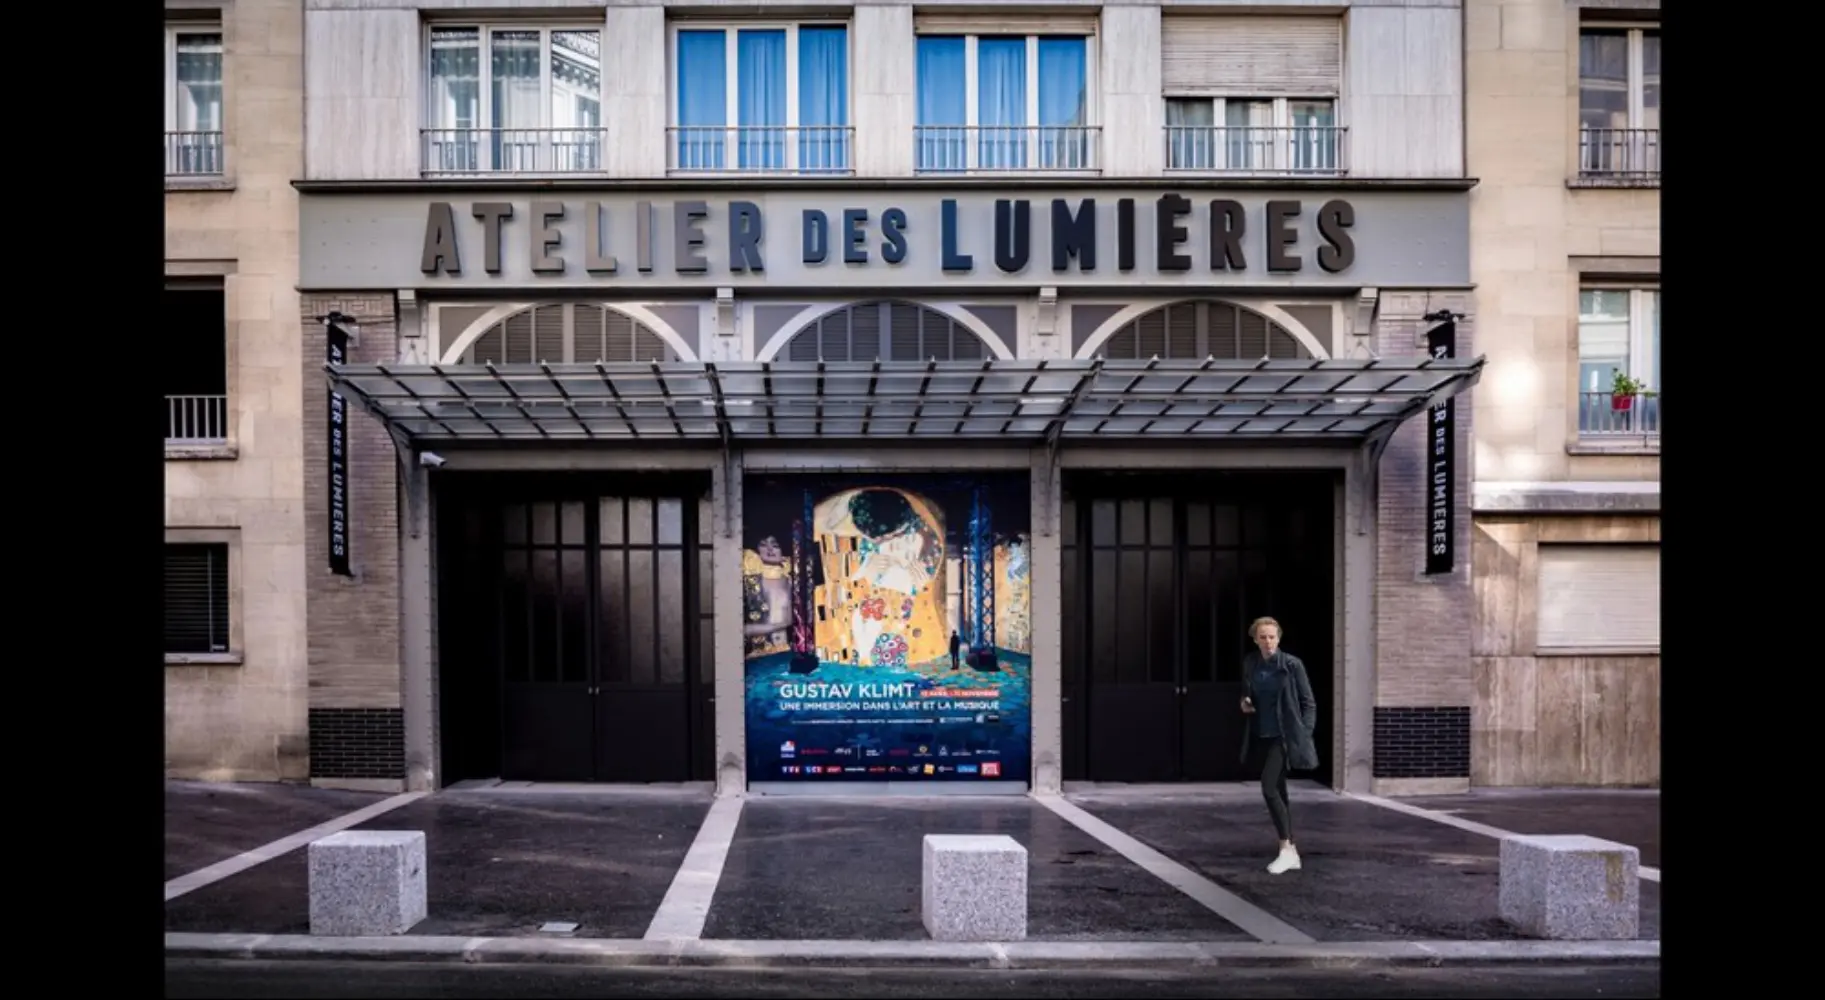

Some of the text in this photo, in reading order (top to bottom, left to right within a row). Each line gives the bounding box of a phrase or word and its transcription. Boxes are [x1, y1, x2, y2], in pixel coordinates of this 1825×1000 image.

[420, 200, 766, 275] ATELIER
[802, 208, 907, 265] DES
[332, 427, 342, 456] DES
[1435, 427, 1446, 456] DES
[780, 683, 915, 699] GUSTAV KLIMT
[780, 701, 801, 711] UNE
[803, 701, 860, 711] IMMERSION
[863, 701, 891, 711] DANS
[923, 701, 935, 710] ET
[937, 701, 952, 710] LA
[954, 700, 999, 711] MUSIQUE
